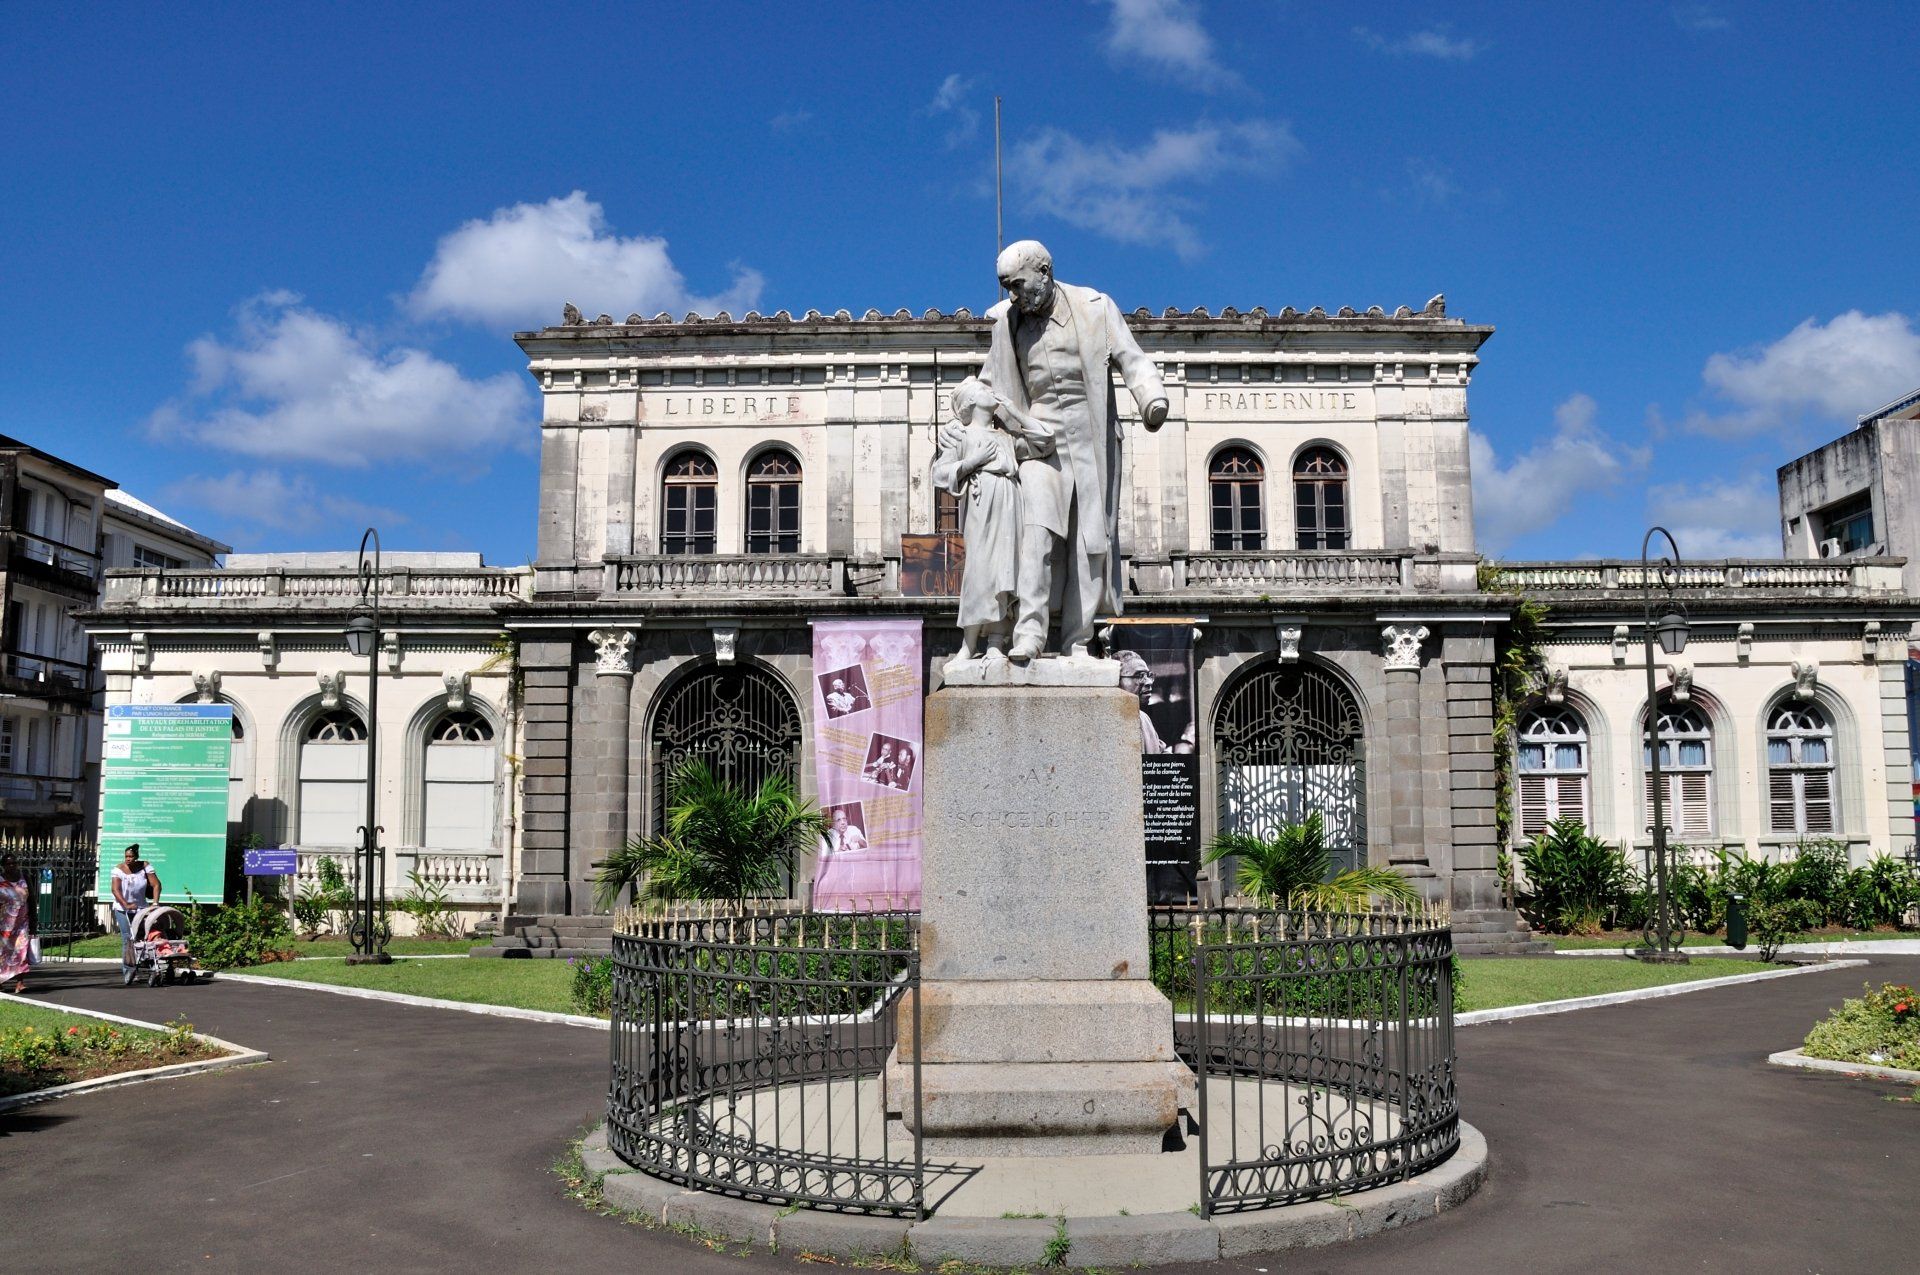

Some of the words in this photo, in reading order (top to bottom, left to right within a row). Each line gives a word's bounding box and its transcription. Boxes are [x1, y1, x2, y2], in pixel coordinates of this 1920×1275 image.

[665, 396, 800, 415] LIBERTE
[1204, 392, 1356, 410] FRATERNITE
[920, 569, 961, 596] CAM
